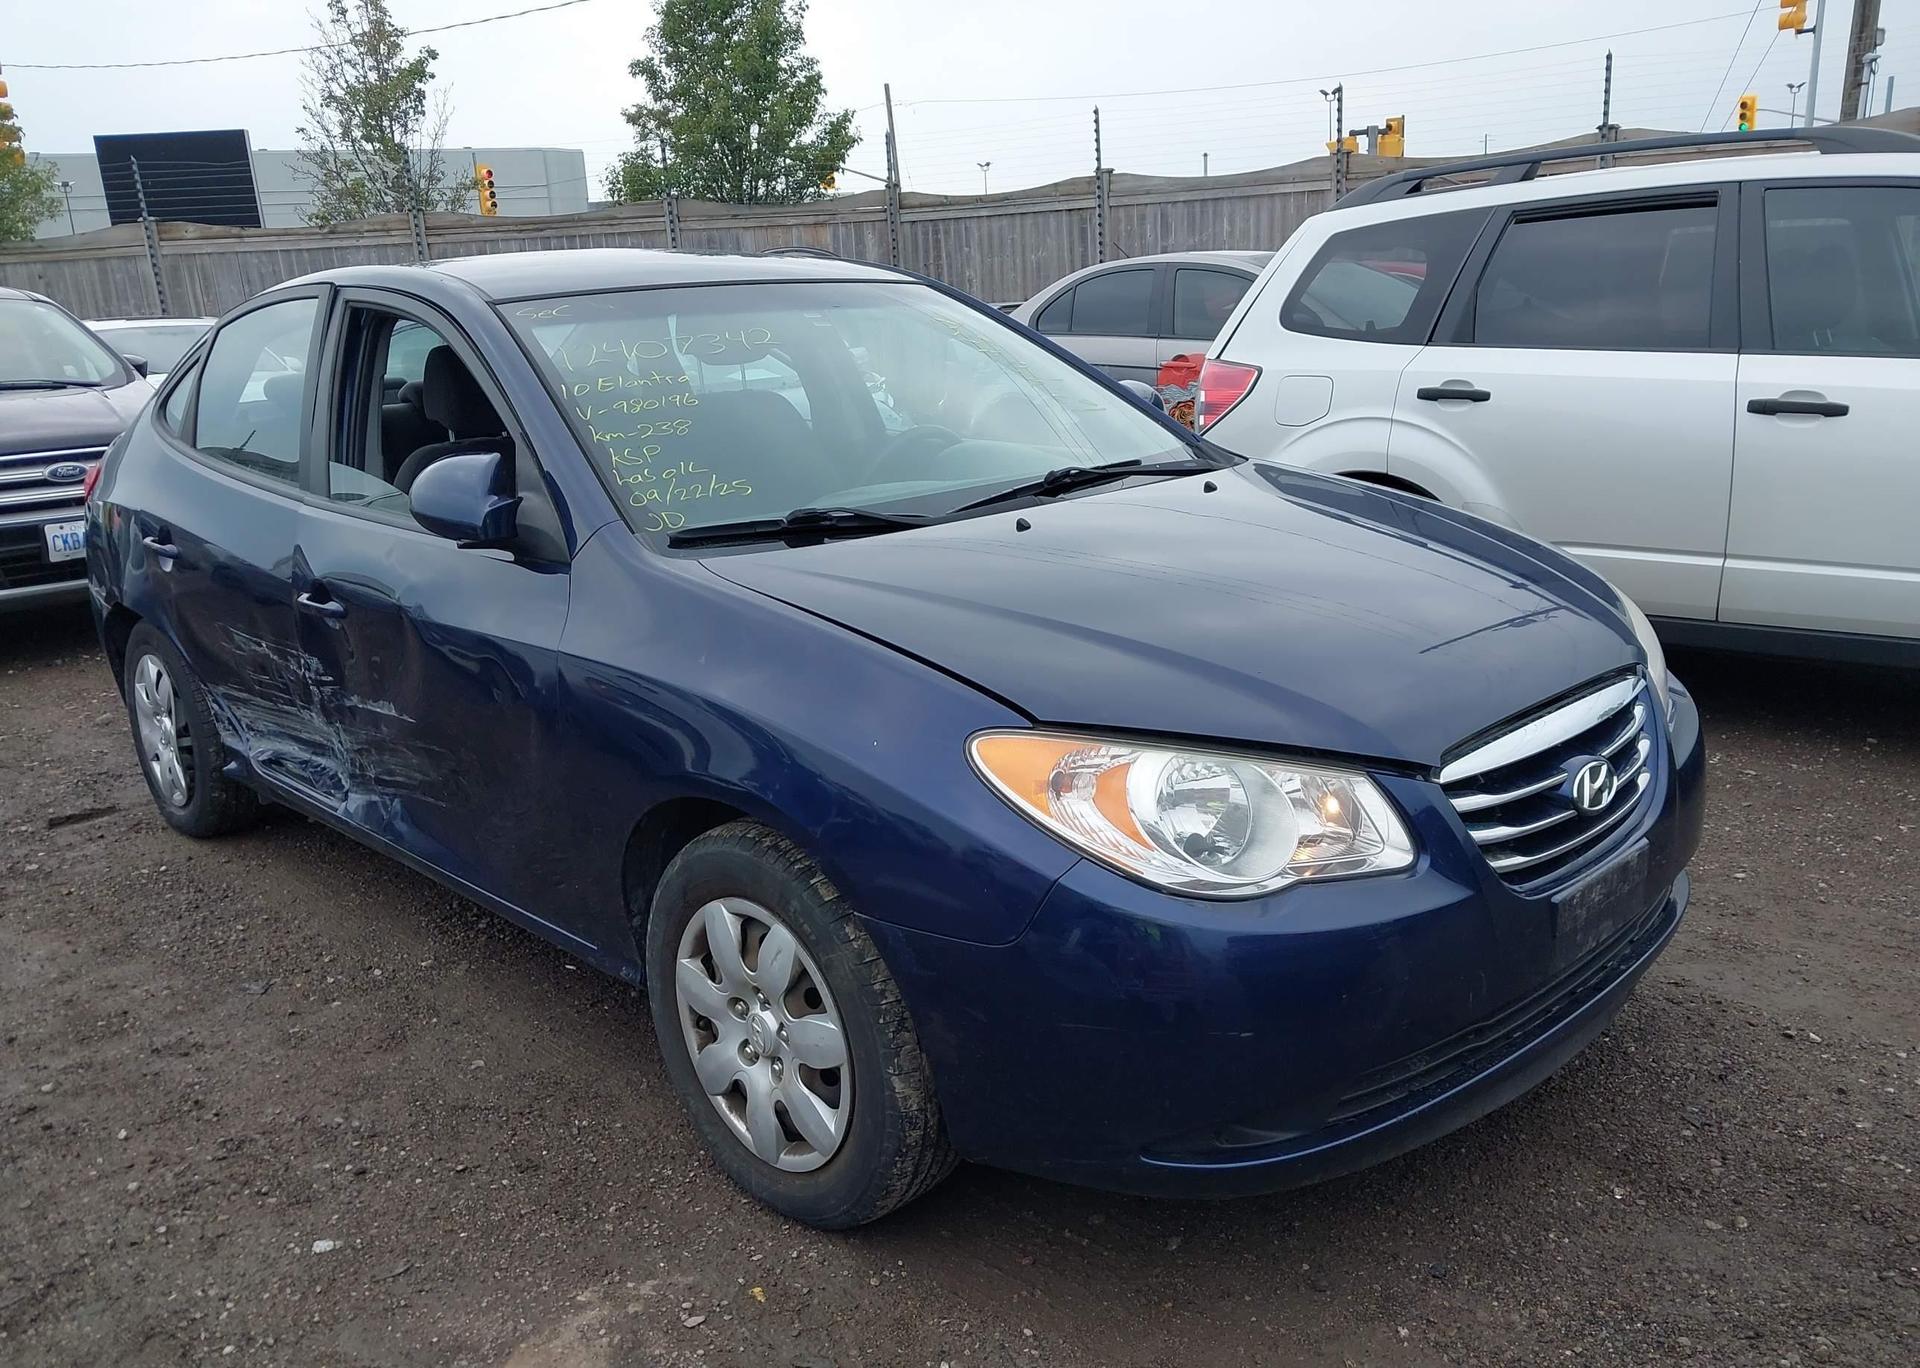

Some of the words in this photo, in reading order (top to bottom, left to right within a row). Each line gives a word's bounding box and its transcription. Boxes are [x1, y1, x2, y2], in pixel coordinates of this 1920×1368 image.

[560, 383, 590, 400] 10
[597, 370, 690, 392] Elantra
[56, 466, 80, 477] Ford
[629, 474, 752, 507] 09/22/25
[645, 511, 685, 532] JD
[52, 532, 86, 552] CKB
